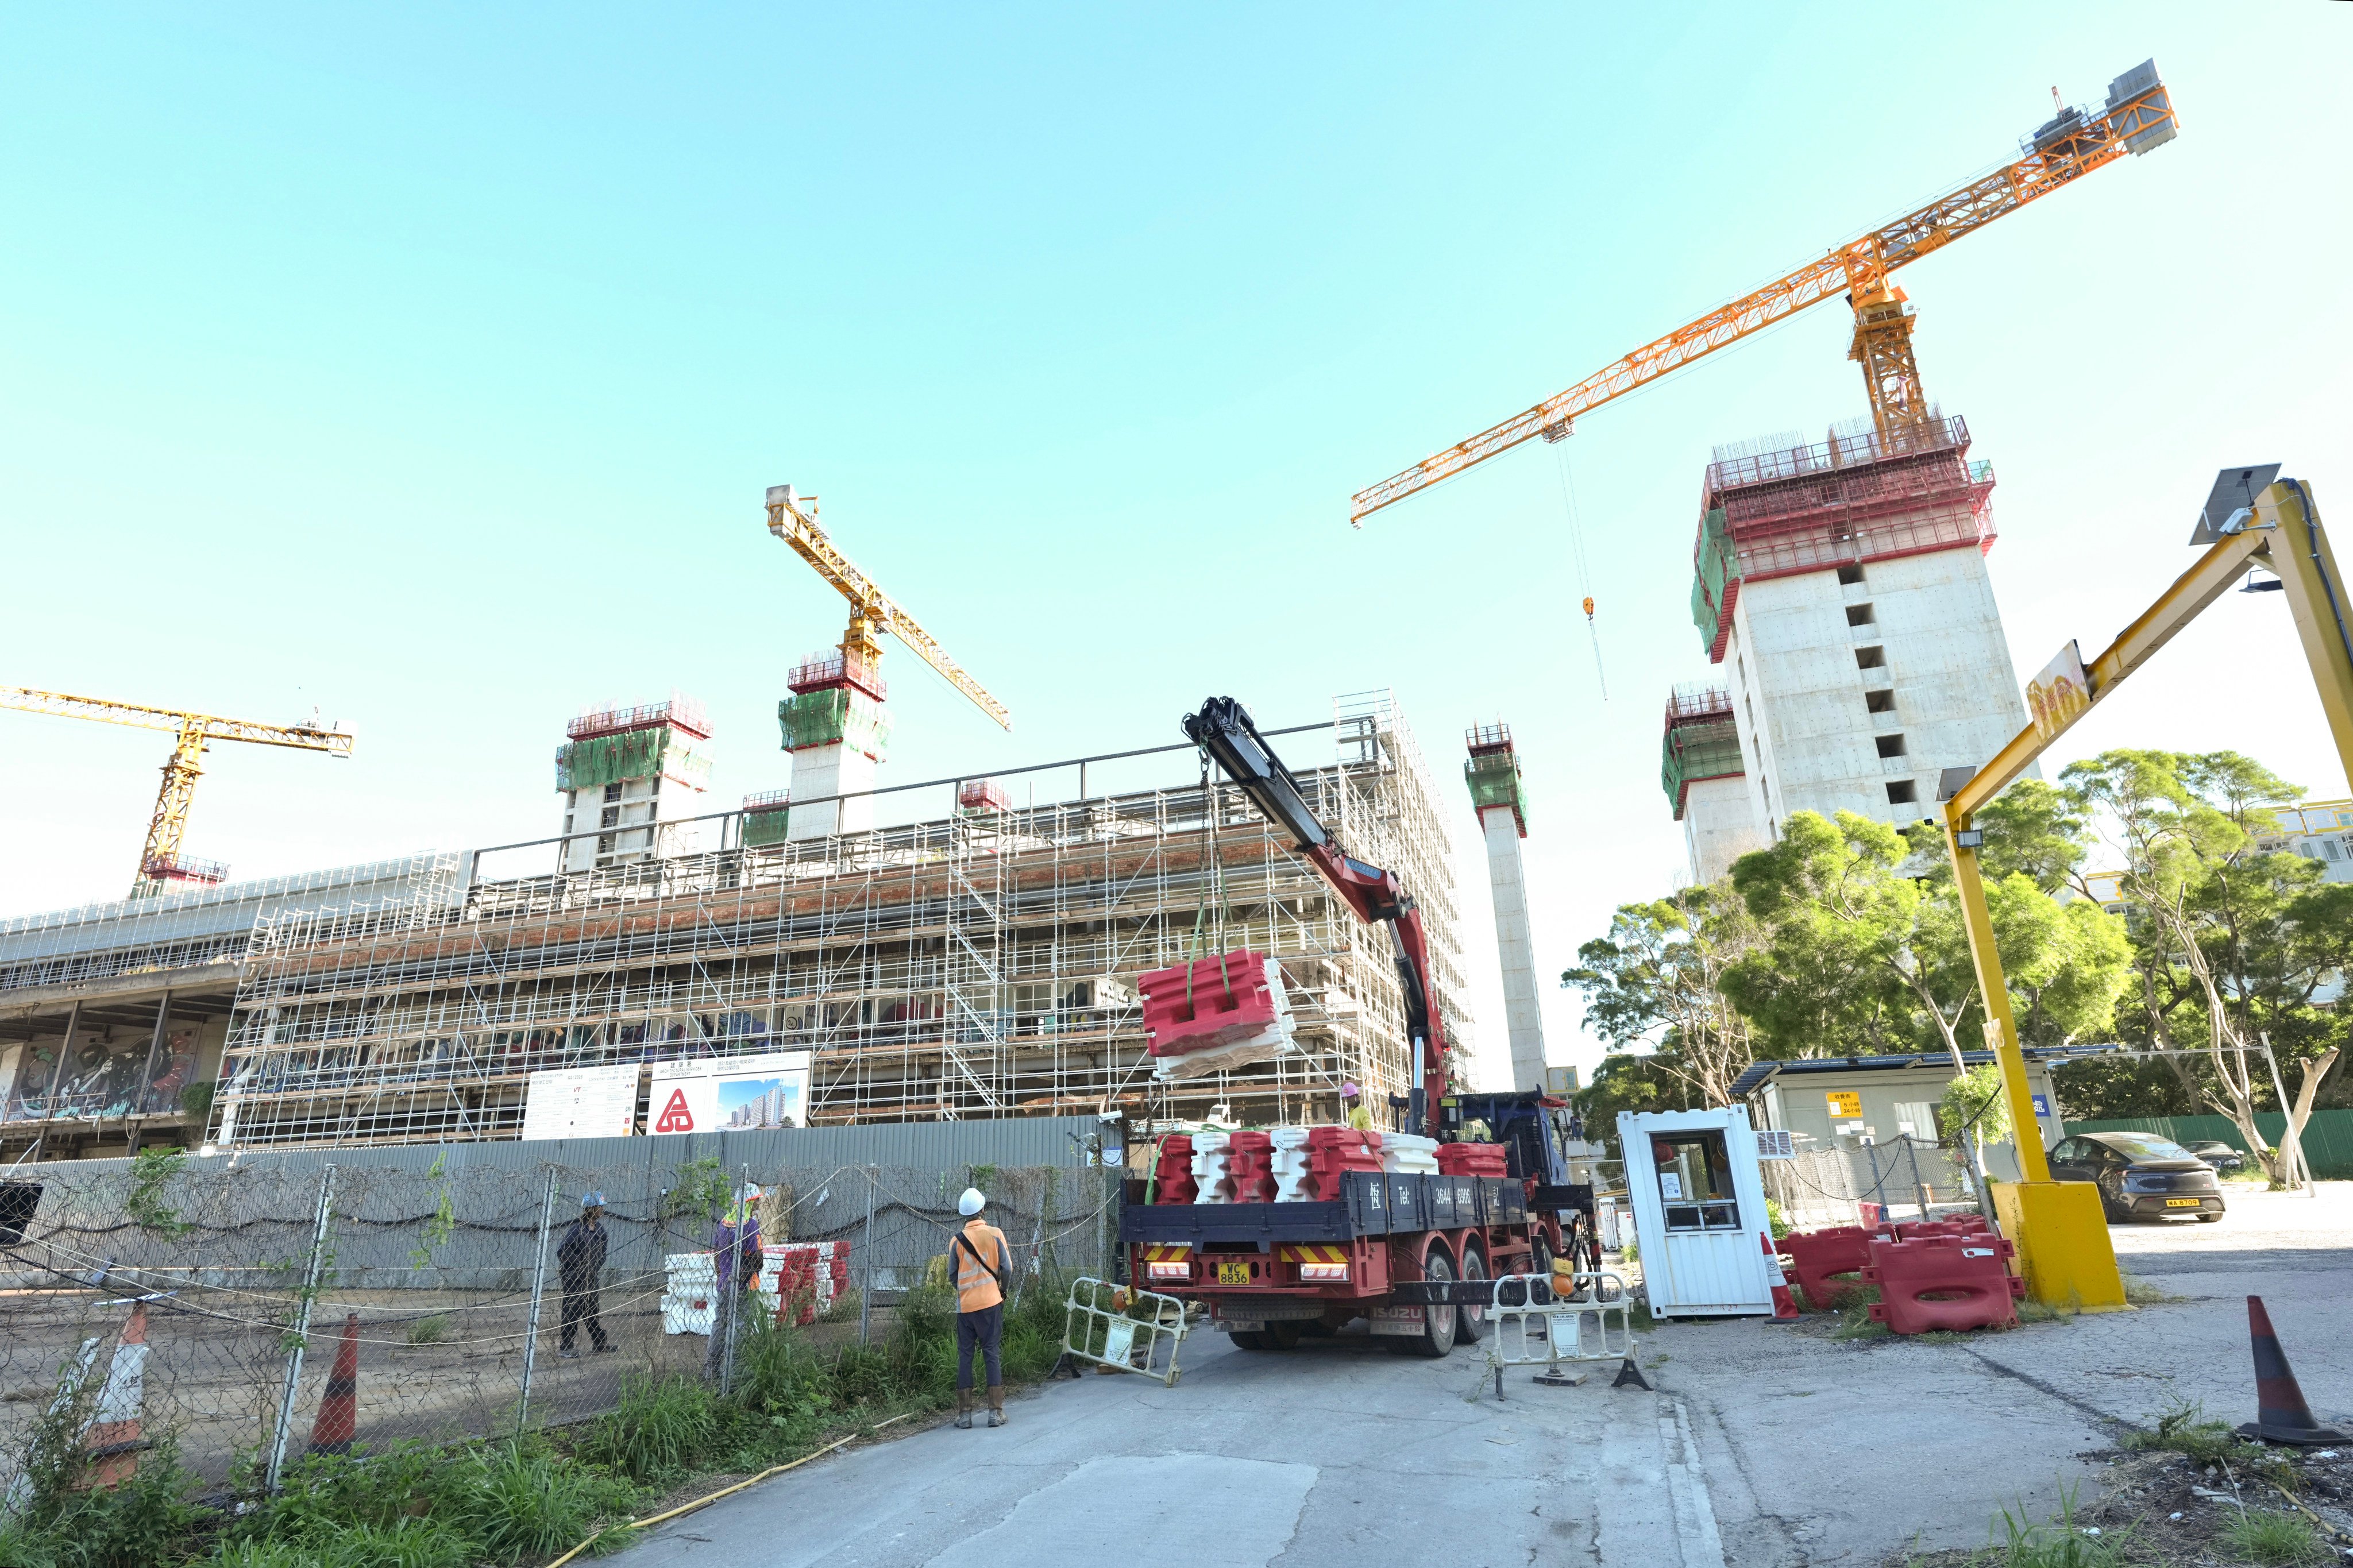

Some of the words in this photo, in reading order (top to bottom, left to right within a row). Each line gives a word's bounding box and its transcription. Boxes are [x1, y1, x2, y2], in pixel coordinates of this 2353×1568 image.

[2032, 1100, 2045, 1113] 處
[1398, 1186, 1410, 1205] Tel:
[1436, 1187, 1451, 1204] 3644
[1457, 1188, 1471, 1204] 6906
[1227, 1264, 1240, 1273] WC
[1221, 1273, 1247, 1284] 8836
[1373, 1307, 1421, 1319] ISUZU
